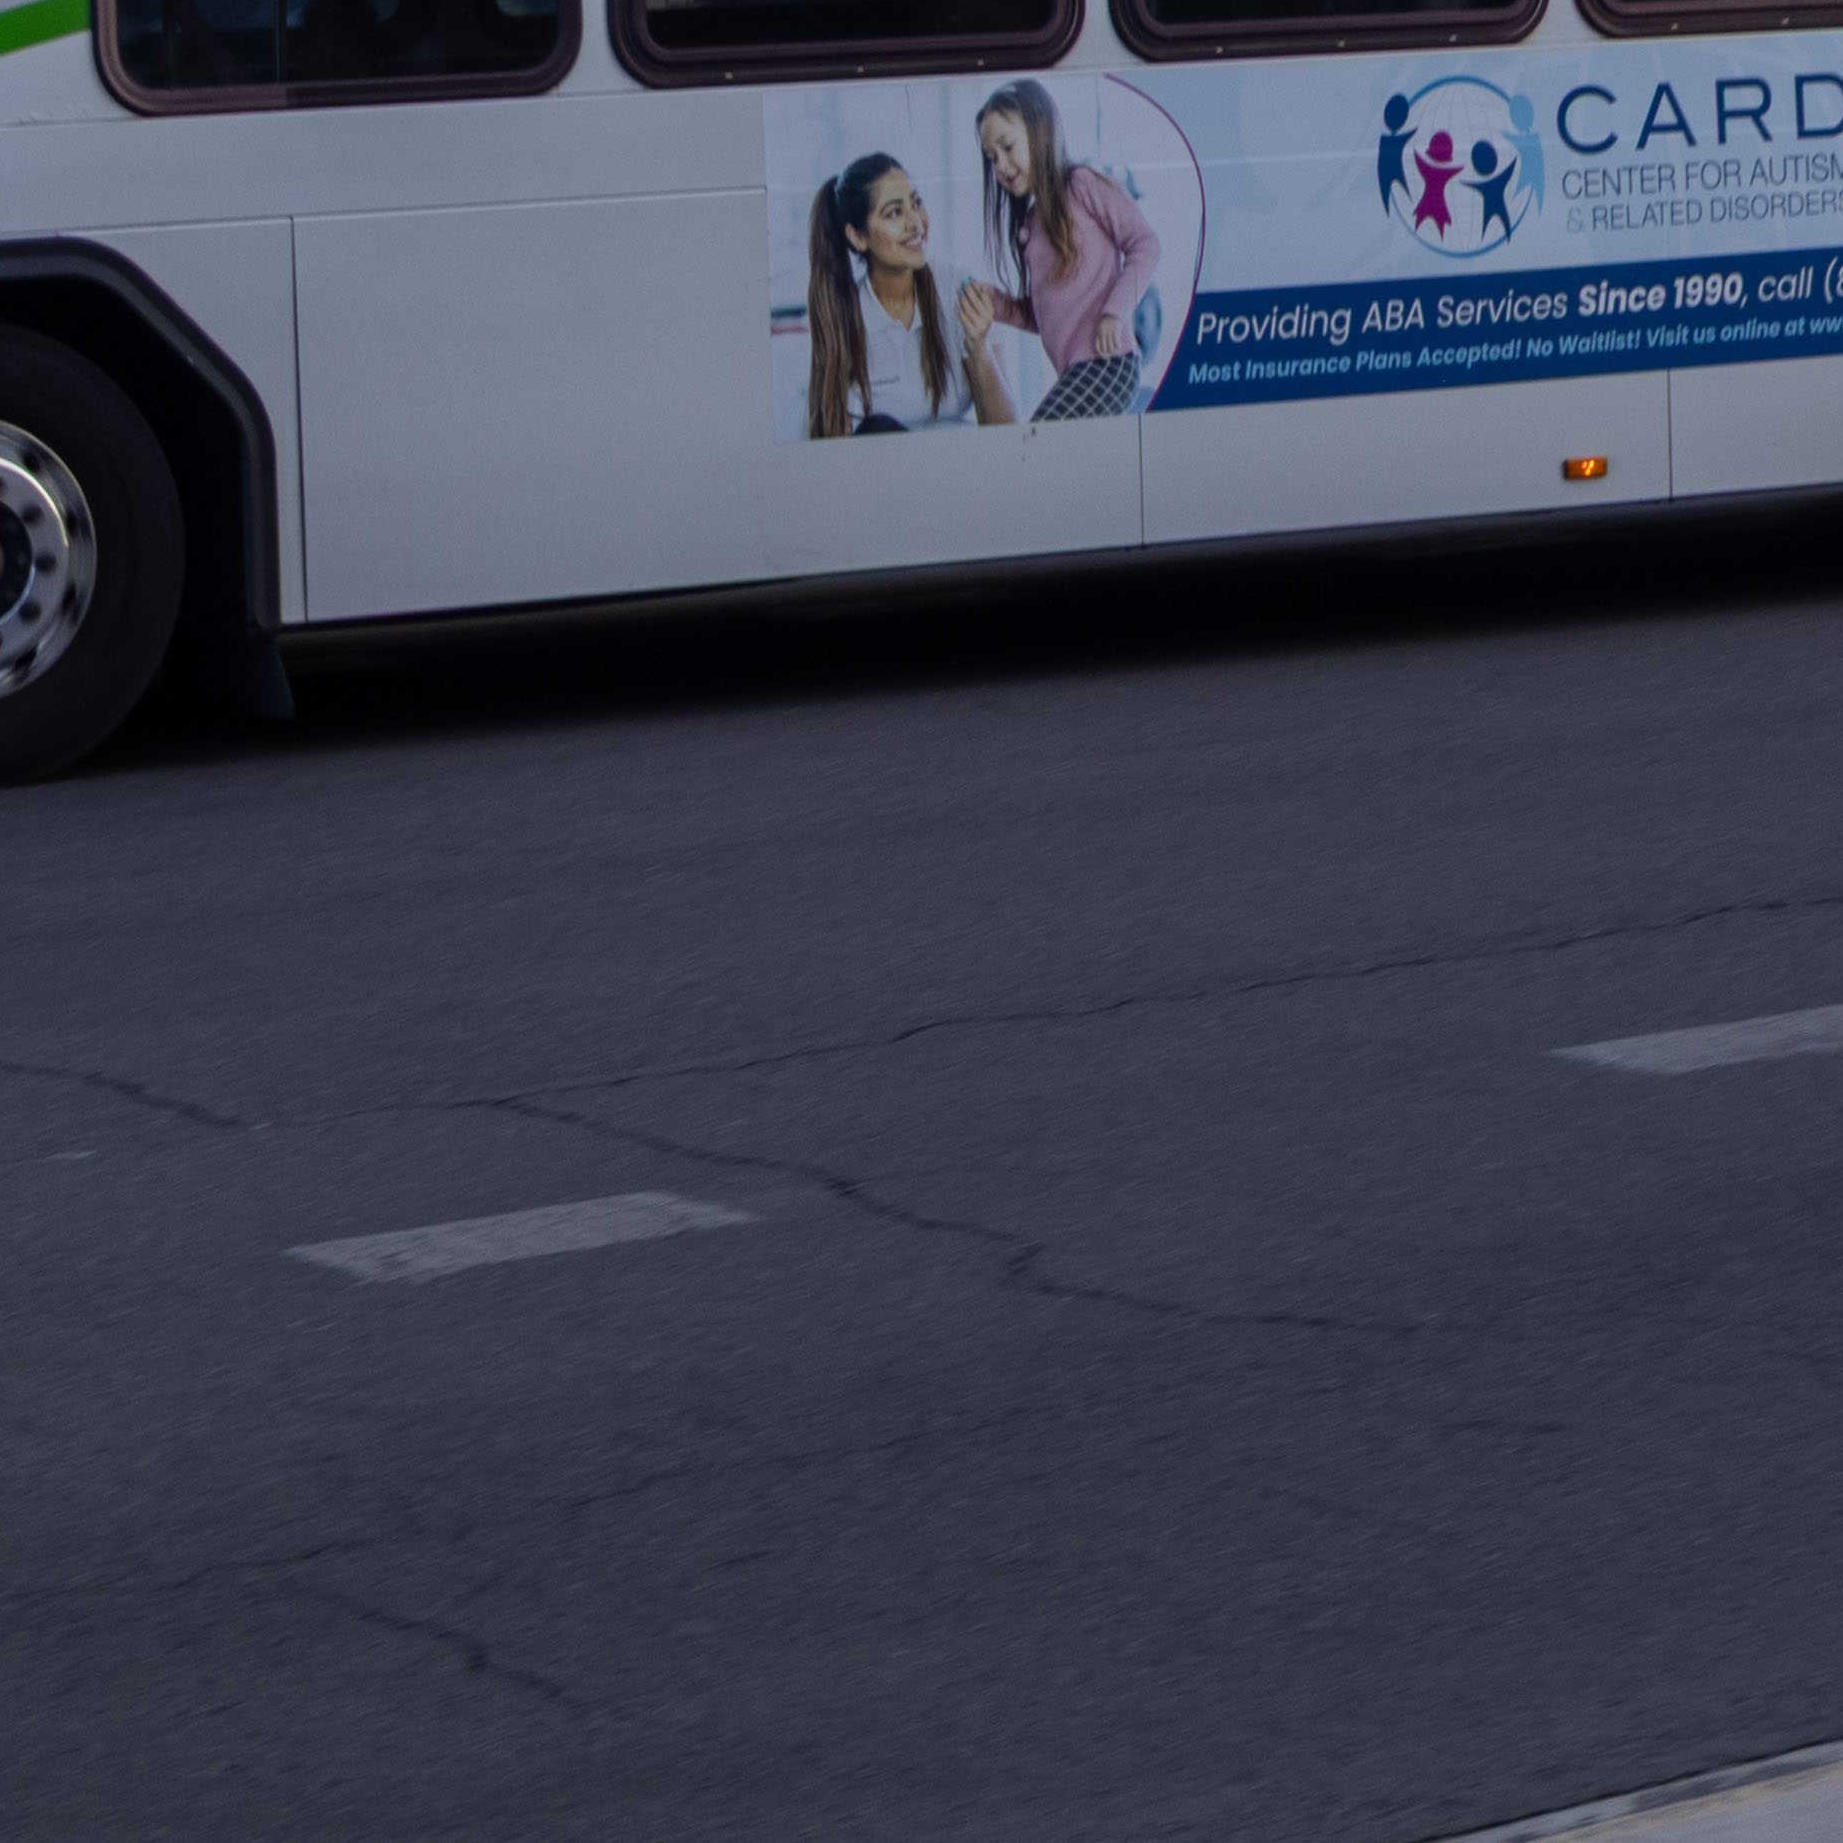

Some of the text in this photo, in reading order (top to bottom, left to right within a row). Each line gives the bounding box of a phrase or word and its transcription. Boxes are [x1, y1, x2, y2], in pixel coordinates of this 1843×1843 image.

[1561, 162, 1677, 200] CENTER
[1685, 159, 1742, 192] FOR
[1567, 211, 1584, 233] &
[1592, 199, 1703, 231] RELATED
[1197, 305, 1352, 346] Providing
[1362, 299, 1425, 333] ABA
[1436, 289, 1568, 328] Services
[1578, 279, 1666, 317] Since
[1673, 272, 1748, 310] 1990,
[1758, 266, 1813, 303] call
[1189, 361, 1241, 384] Most
[1245, 354, 1351, 380] Insurance
[1356, 348, 1411, 371] Plans
[1417, 339, 1522, 368] Accepted!
[1526, 337, 1554, 358] No
[1558, 329, 1641, 356] Waitlist!
[1646, 324, 1690, 349] Visit
[1693, 326, 1716, 344] us
[1720, 317, 1780, 342] online
[1784, 317, 1806, 337] at
